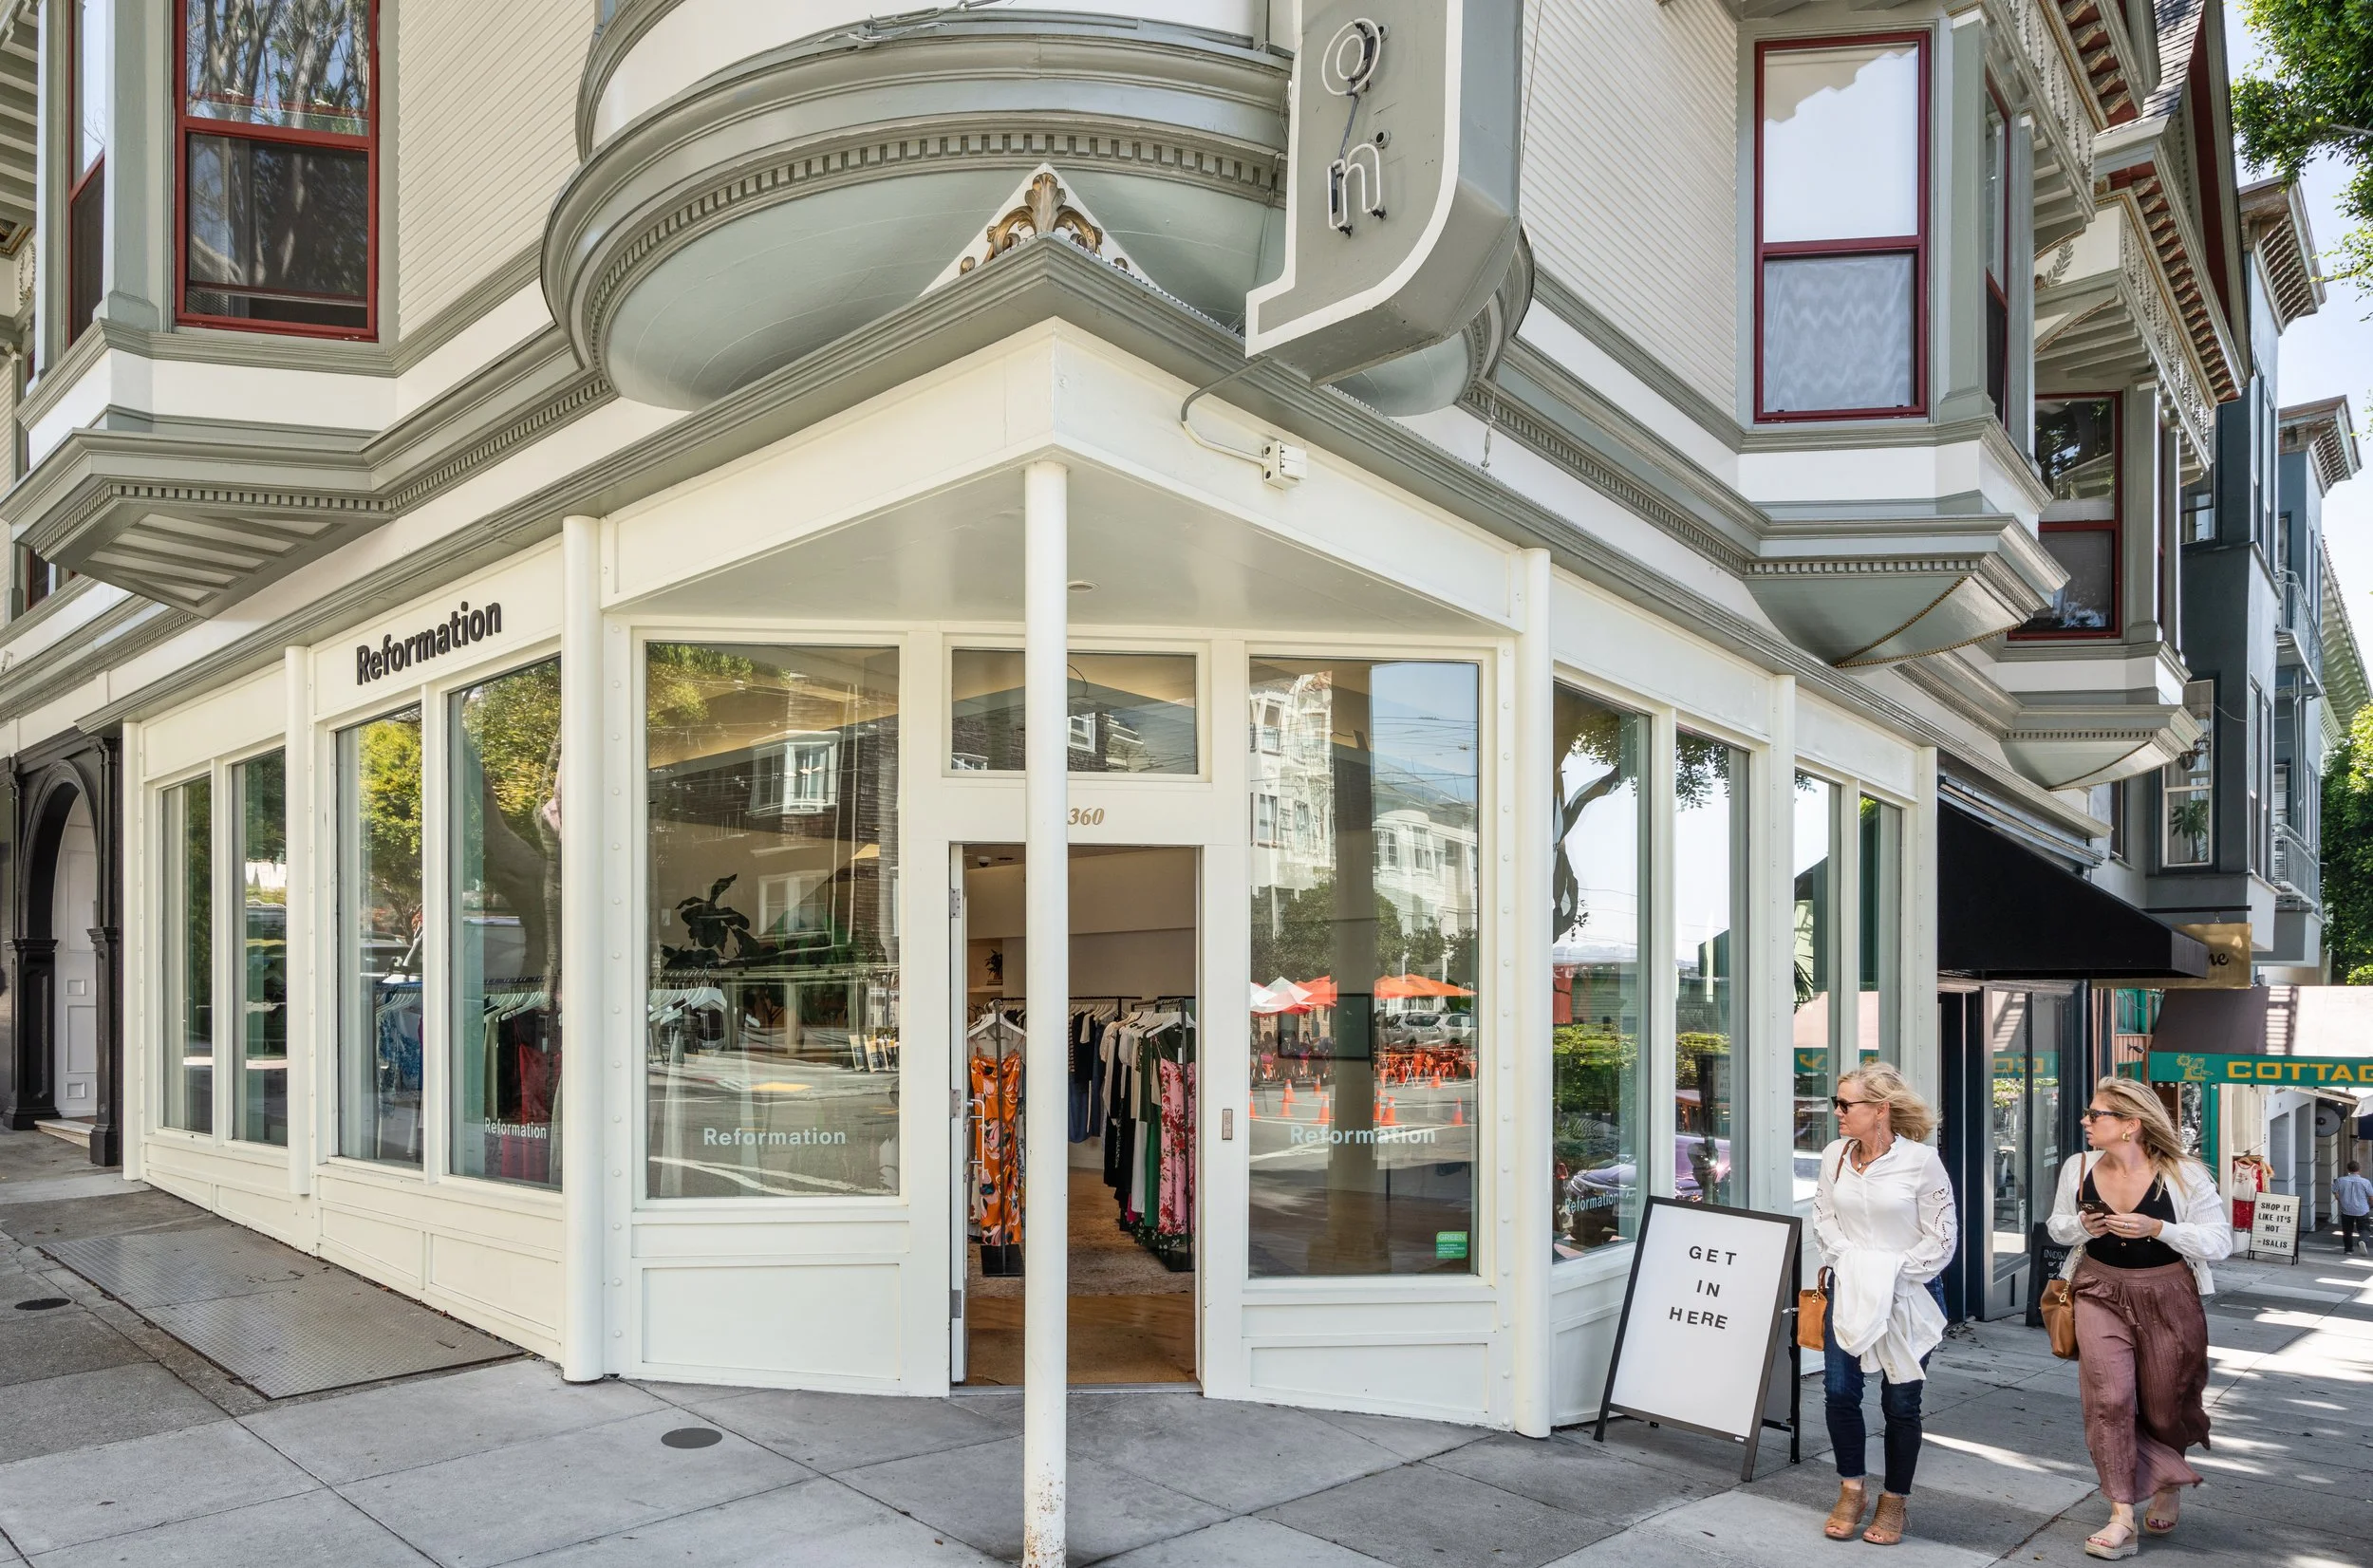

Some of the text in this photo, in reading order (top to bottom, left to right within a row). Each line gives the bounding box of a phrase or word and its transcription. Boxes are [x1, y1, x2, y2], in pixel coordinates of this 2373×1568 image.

[356, 601, 502, 685] Reformation
[484, 1116, 547, 1139] Reformation
[703, 1127, 846, 1146] Reformation
[1290, 1125, 1436, 1145] Reformation
[1564, 1190, 1619, 1214] Reformation
[2260, 1202, 2280, 1211] SHOP
[2265, 1224, 2280, 1233] HOT
[1689, 1245, 1737, 1266] GET
[1695, 1279, 1721, 1297] IN
[1669, 1306, 1728, 1330] HERE
